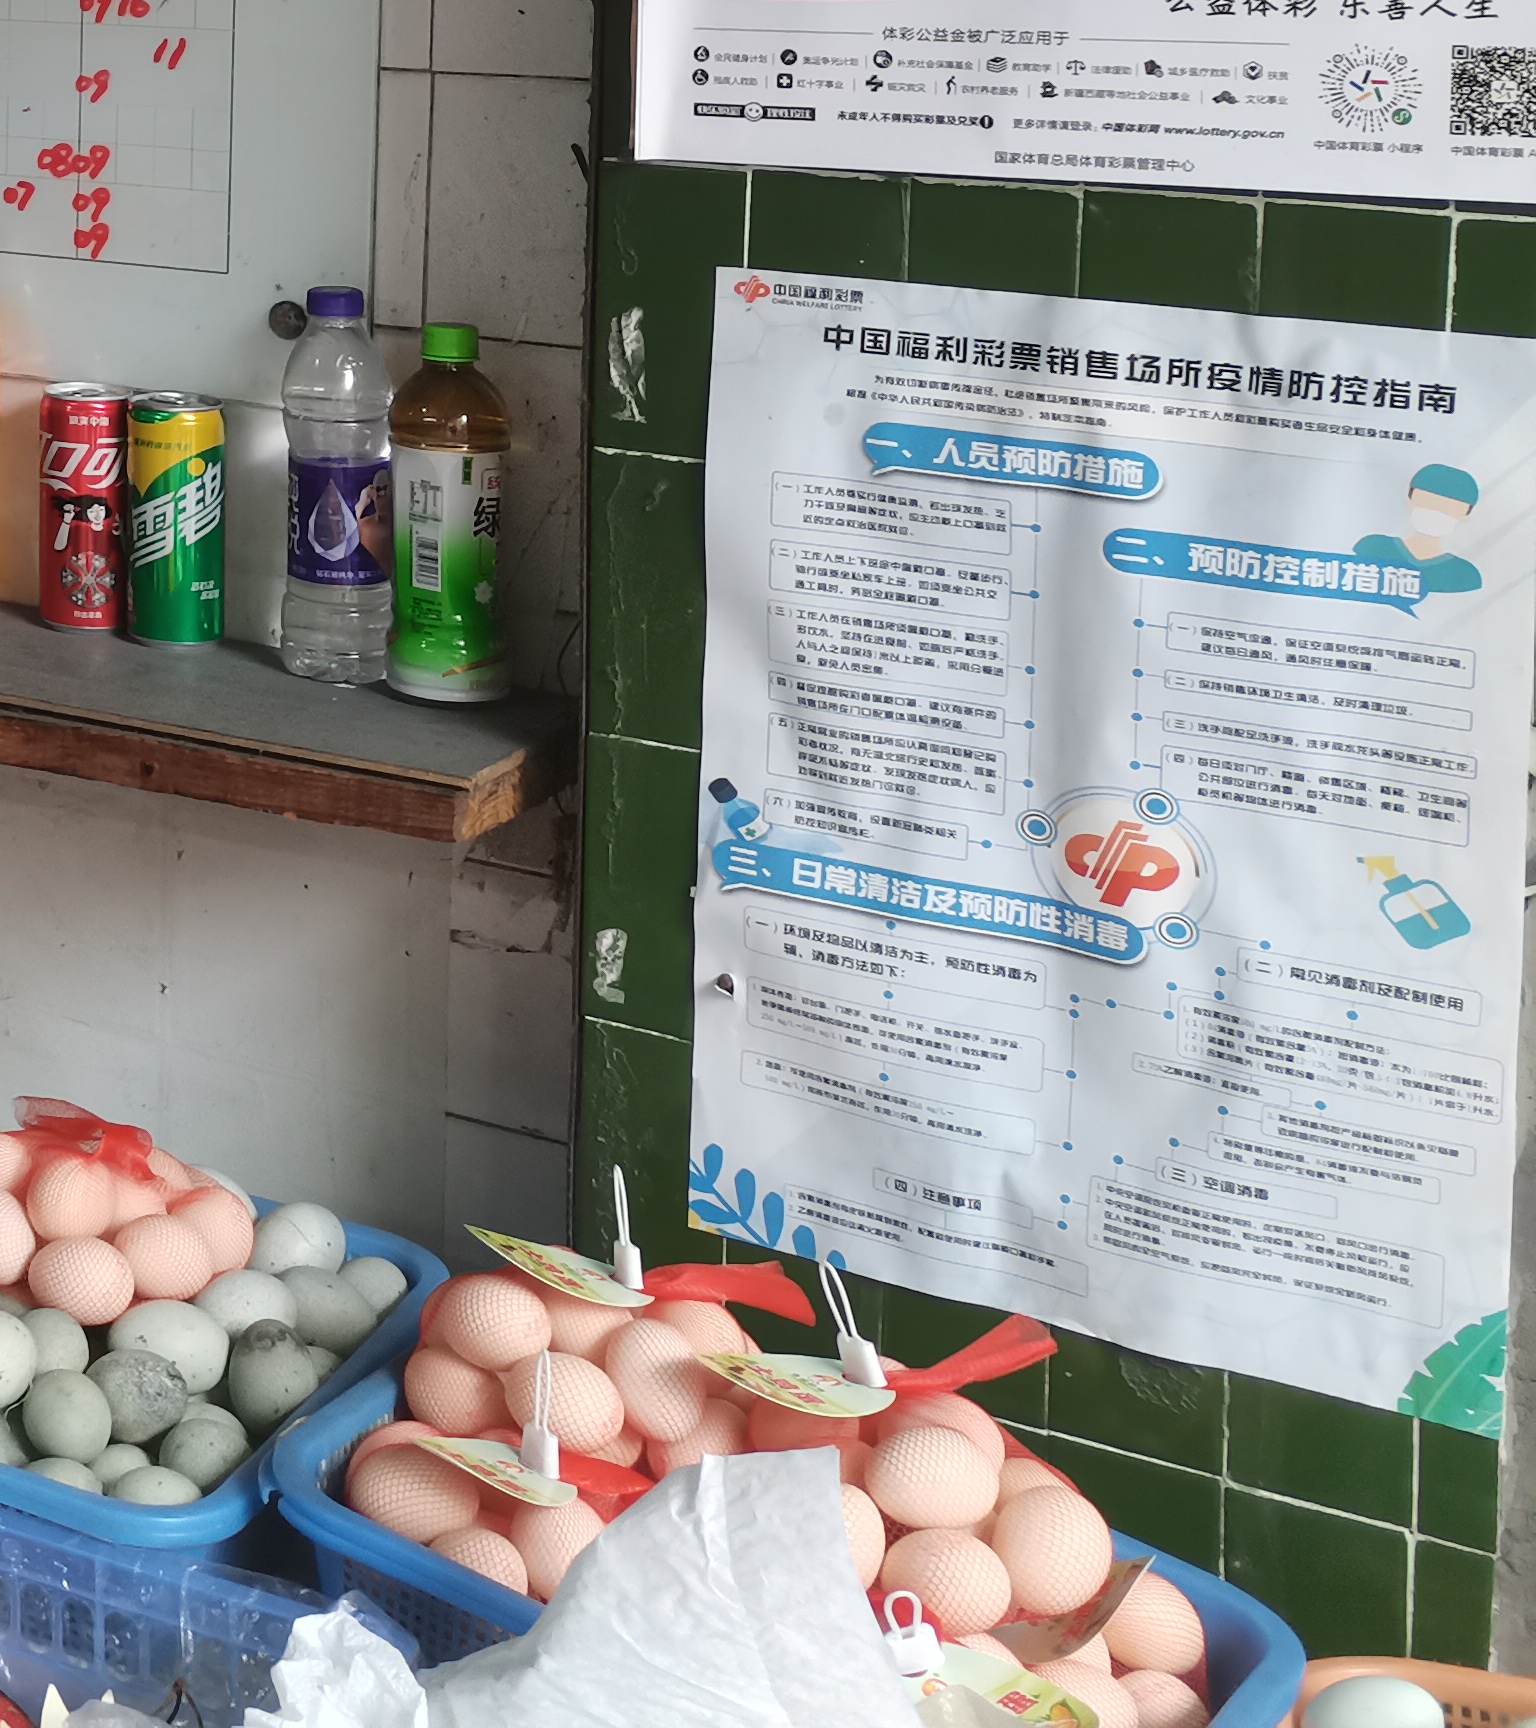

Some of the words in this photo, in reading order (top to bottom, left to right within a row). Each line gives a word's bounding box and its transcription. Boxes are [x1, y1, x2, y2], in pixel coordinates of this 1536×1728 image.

[881, 23, 1070, 48] 体彩公益金被广泛应用于
[823, 324, 1457, 414] 中国福利彩票销售场所疫情防控指南
[865, 434, 1145, 489] 一、人员预防措施
[130, 469, 225, 568] 雪碧
[1110, 536, 1422, 599] 二、预防控制措施
[728, 845, 1130, 951] 三、日常清洁及预防性消毒
